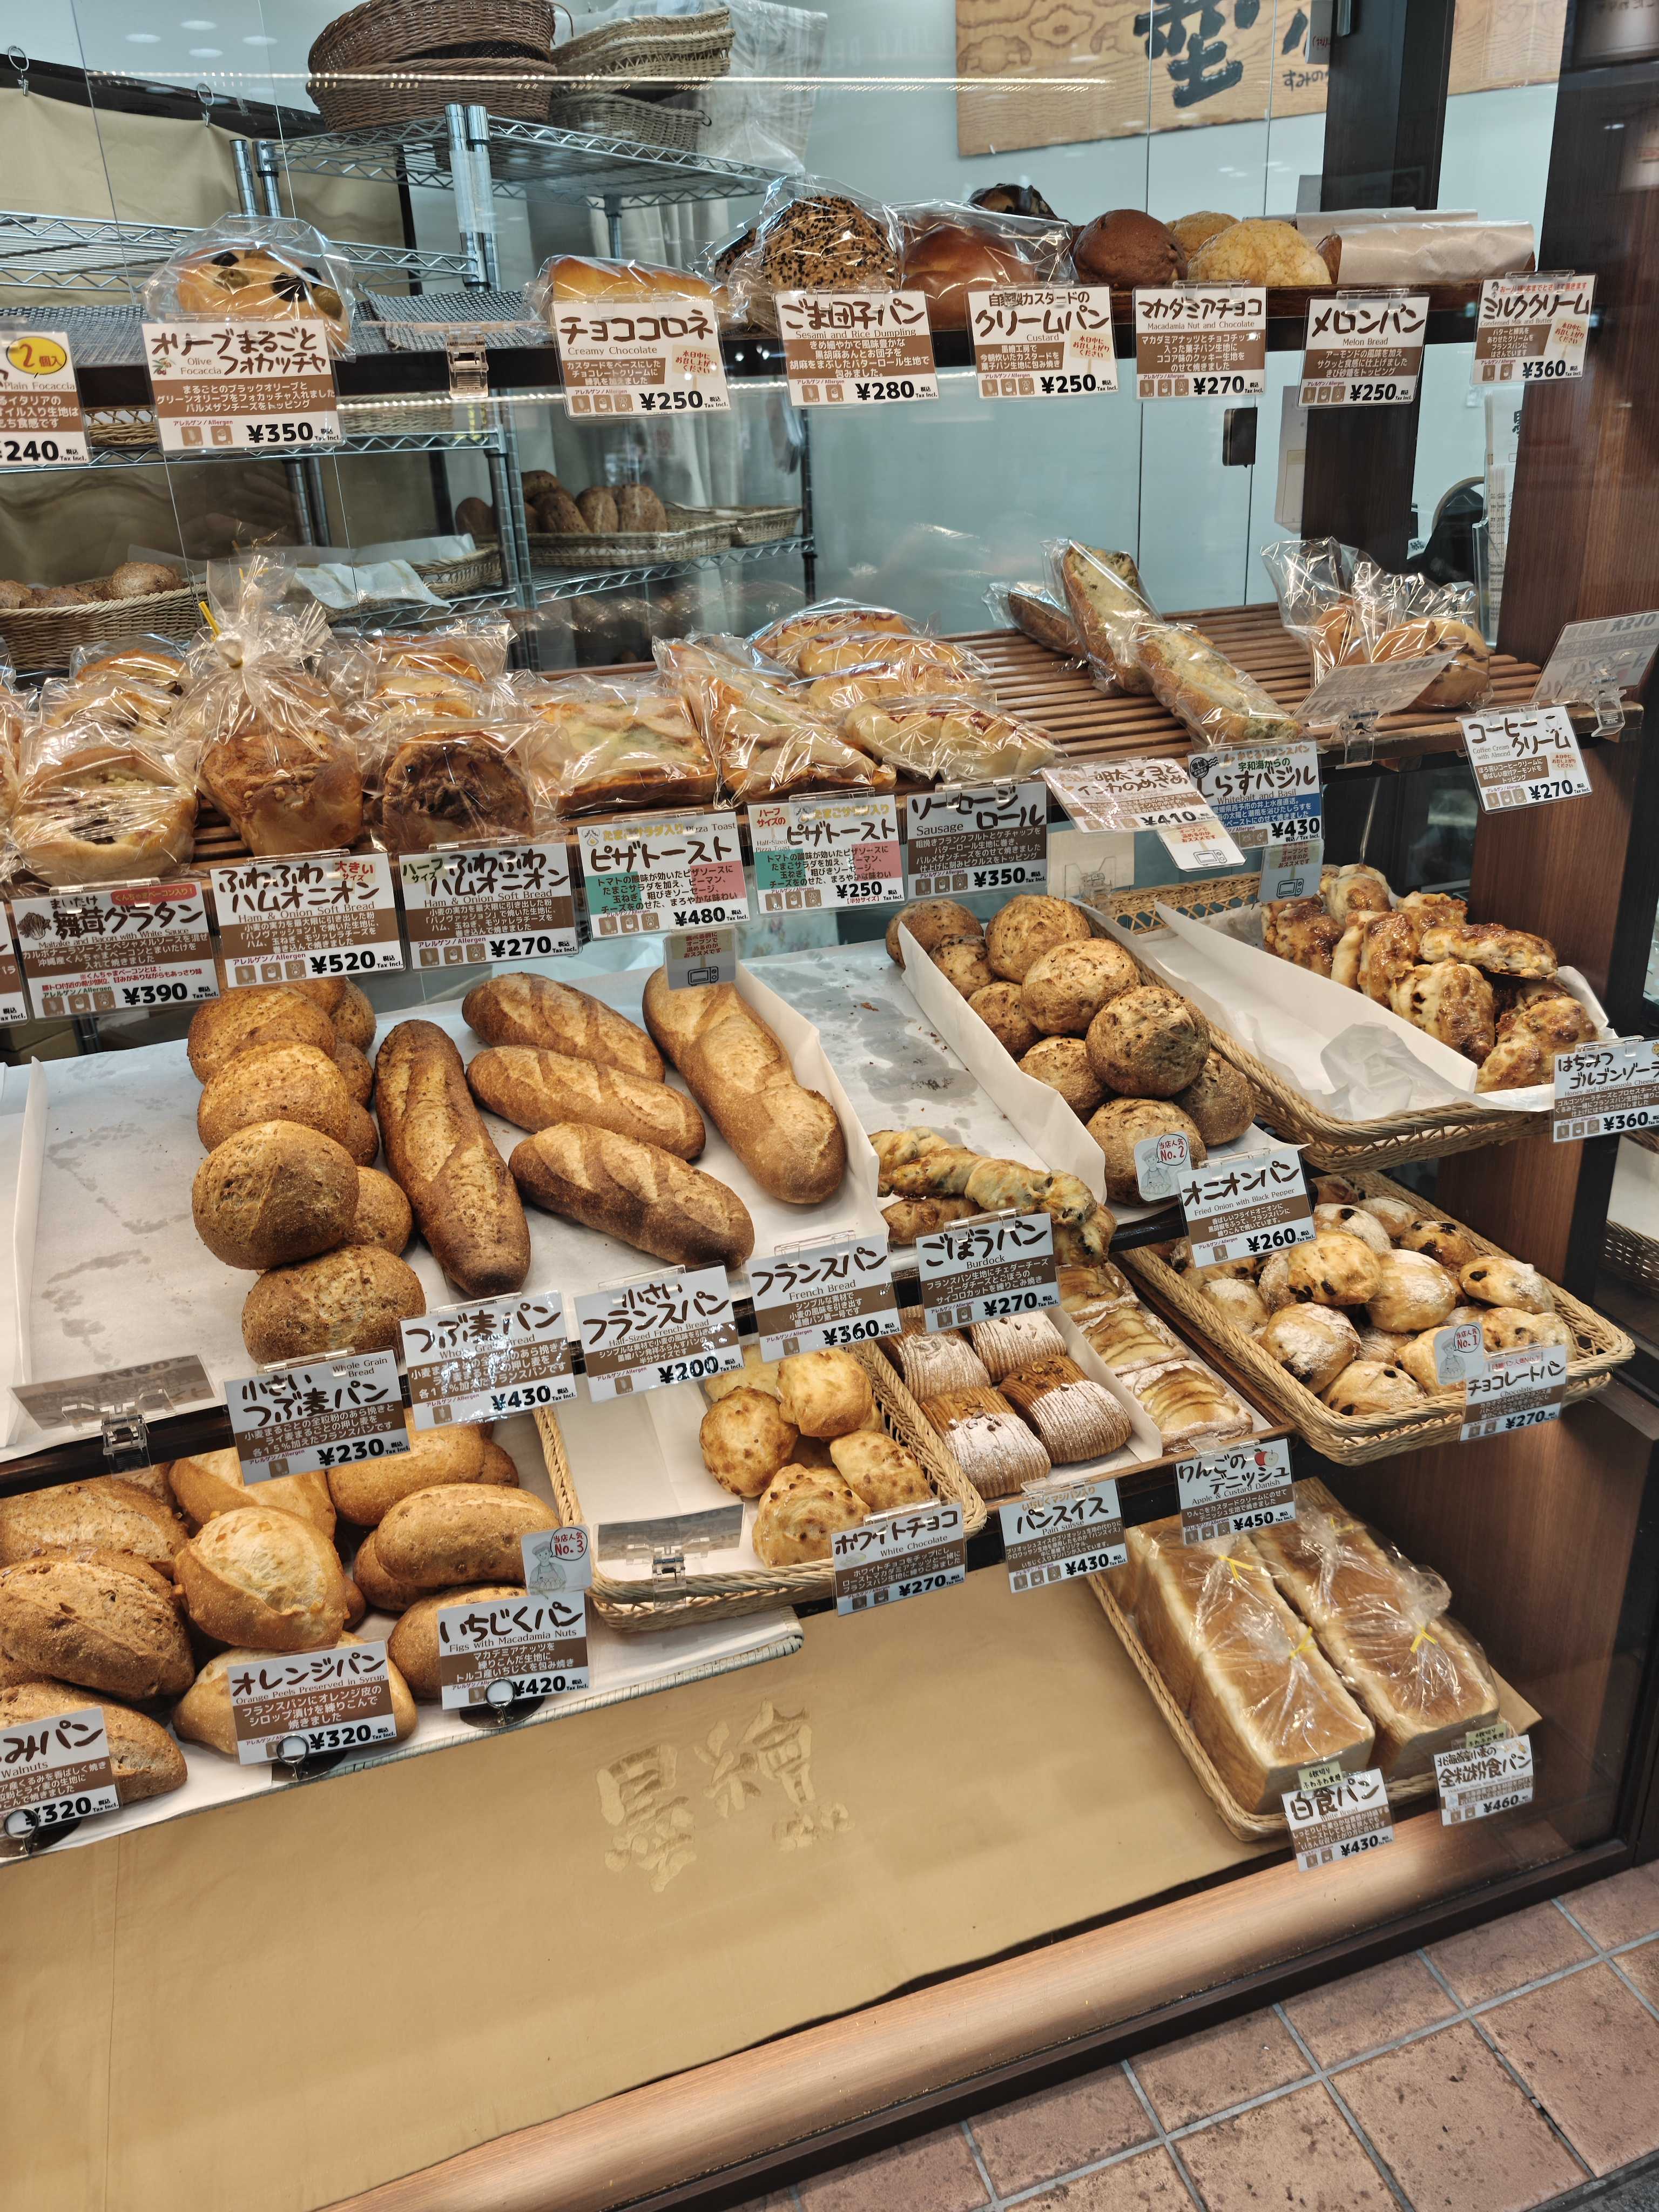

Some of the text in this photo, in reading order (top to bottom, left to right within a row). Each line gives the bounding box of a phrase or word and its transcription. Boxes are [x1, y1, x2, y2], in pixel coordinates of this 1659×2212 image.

[1283, 70, 1330, 91] すみの
[782, 298, 925, 330] ごま団子パン
[1138, 296, 1262, 320] マカダミアチョコ
[1483, 293, 1589, 319] ミルククリーム
[560, 309, 713, 345] チョココロネ
[975, 305, 1109, 337] クリームパン
[1312, 304, 1425, 337] メロンパン
[796, 331, 826, 339] Sesami
[874, 328, 916, 338] Dumpling
[1027, 334, 1059, 342] Custard
[568, 346, 657, 355] Creamy Chocolate
[1157, 352, 1244, 363] ココア味のクッキー生地を
[180, 367, 221, 375] Focaccia
[219, 352, 326, 375] フォカッチャ
[1171, 362, 1230, 373] のせて焼きました
[1522, 360, 1566, 378] ¥360
[4, 381, 76, 390] Plain Focaccia
[183, 382, 307, 394] まるごとのブラックオリーブと
[855, 381, 914, 401] ¥280
[1040, 374, 1096, 394] ¥250
[1193, 376, 1244, 395] ¥270
[1350, 383, 1397, 401] ¥250
[639, 390, 703, 411] ¥250
[246, 422, 313, 443] ¥350
[0, 441, 59, 461] 240
[1468, 718, 1537, 744] コーヒー
[1512, 731, 1571, 757] クリーム
[1238, 758, 1290, 771] 宇和海からの
[1197, 766, 1316, 798] しらすバジル
[1529, 780, 1573, 800] ¥270
[912, 786, 1018, 820] ソーセージ
[1217, 794, 1255, 804] Whitebait
[757, 817, 786, 826] サイズの
[759, 808, 780, 817] ハーフ
[976, 804, 1044, 830] ロール
[1141, 811, 1196, 825] ¥410
[787, 819, 895, 847] ピザトースト
[916, 823, 964, 836] Sausage
[1272, 818, 1319, 838] ¥430
[449, 848, 546, 876] ふわふわ
[591, 836, 732, 872] ピザトースト
[219, 862, 323, 892] ふわふわ
[335, 861, 374, 874] 大きい
[343, 873, 364, 882] サイズ
[403, 859, 442, 876] ハーフ
[412, 872, 436, 883] サイズ
[597, 865, 733, 887] トマトの酸味が効いたピザソースに
[974, 867, 1026, 887] ¥350
[431, 868, 569, 896] ハムオニオン
[837, 881, 882, 898] ¥250
[232, 881, 379, 913] ハムオニオン
[601, 892, 738, 913] チーズをのせた、まろやかな味わい
[53, 902, 203, 940] 舞茸グラタン
[238, 914, 262, 923] Ham
[280, 909, 313, 919] Onion
[318, 906, 339, 915] Soft
[344, 902, 375, 912] Bread
[673, 907, 725, 927] ¥480
[490, 936, 551, 957] ¥270
[310, 950, 376, 974] ¥520
[122, 982, 187, 1005] ¥390
[1559, 1053, 1613, 1071] はちみつ
[1570, 1061, 1659, 1089] ゴルゴンゾーラ
[1603, 1112, 1648, 1131] ¥360
[1159, 1138, 1184, 1149] 当店人気
[1183, 1161, 1299, 1206] オニオンパン
[1195, 1189, 1296, 1216] Fried Onion with Black Pepper
[922, 1220, 1048, 1266] ごぼうパン
[1246, 1228, 1296, 1252] ¥260
[752, 1247, 887, 1296] フランスパン
[967, 1255, 1005, 1269] Burdock
[927, 1258, 1049, 1290] フランスパン生地にチェダーチーズ
[947, 1270, 1030, 1294] ゴーダチーズとごぼうの
[622, 1284, 682, 1309] 小さい
[790, 1280, 856, 1300] French Bread
[936, 1276, 1043, 1304] サイコロカットを練りこみ焼き
[983, 1293, 1037, 1317] ¥270
[583, 1291, 729, 1345] フランスパン
[822, 1320, 879, 1346] ¥360
[332, 1358, 388, 1372] Whole Grain
[348, 1368, 374, 1378] Bread
[658, 1356, 718, 1384] ¥200
[242, 1374, 312, 1400] 小さい
[1468, 1361, 1565, 1396] チョコレートパン
[243, 1381, 388, 1427] つぶ麦パン
[491, 1385, 550, 1411] ¥430
[245, 1404, 394, 1441] 小麦まるごとの全粒粉のあら挽きと
[266, 1416, 377, 1445] ライ麦まるごとの押し麦を
[1506, 1411, 1545, 1429] ¥270
[317, 1439, 384, 1466] ¥230
[1179, 1454, 1247, 1482] りんごの
[1210, 1467, 1289, 1494] デニッシュ
[1017, 1497, 1109, 1534] パンスイス
[1233, 1512, 1273, 1530] ¥450
[554, 1532, 583, 1543] 当店人気
[835, 1511, 957, 1555] ホワイトチョコ
[880, 1535, 947, 1557] White Chocolate
[1065, 1554, 1109, 1575] ¥430
[899, 1575, 946, 1596] ¥270
[440, 1602, 583, 1643] いちじくパン
[450, 1629, 577, 1653] Figs with Macadamia Nuts
[232, 1653, 385, 1697] オレンジパン
[514, 1676, 566, 1697] ¥420
[242, 1686, 381, 1717] フランスパンにオレンジ皮の
[0, 1720, 103, 1763] みパン
[309, 1725, 371, 1750] ¥320
[1, 1762, 48, 1778] Walnuts
[1439, 1754, 1530, 1787] 全粒粉食パン
[1290, 1778, 1379, 1820] 白食パン
[1483, 1795, 1519, 1813] ¥460
[1340, 1835, 1378, 1857] ¥430
